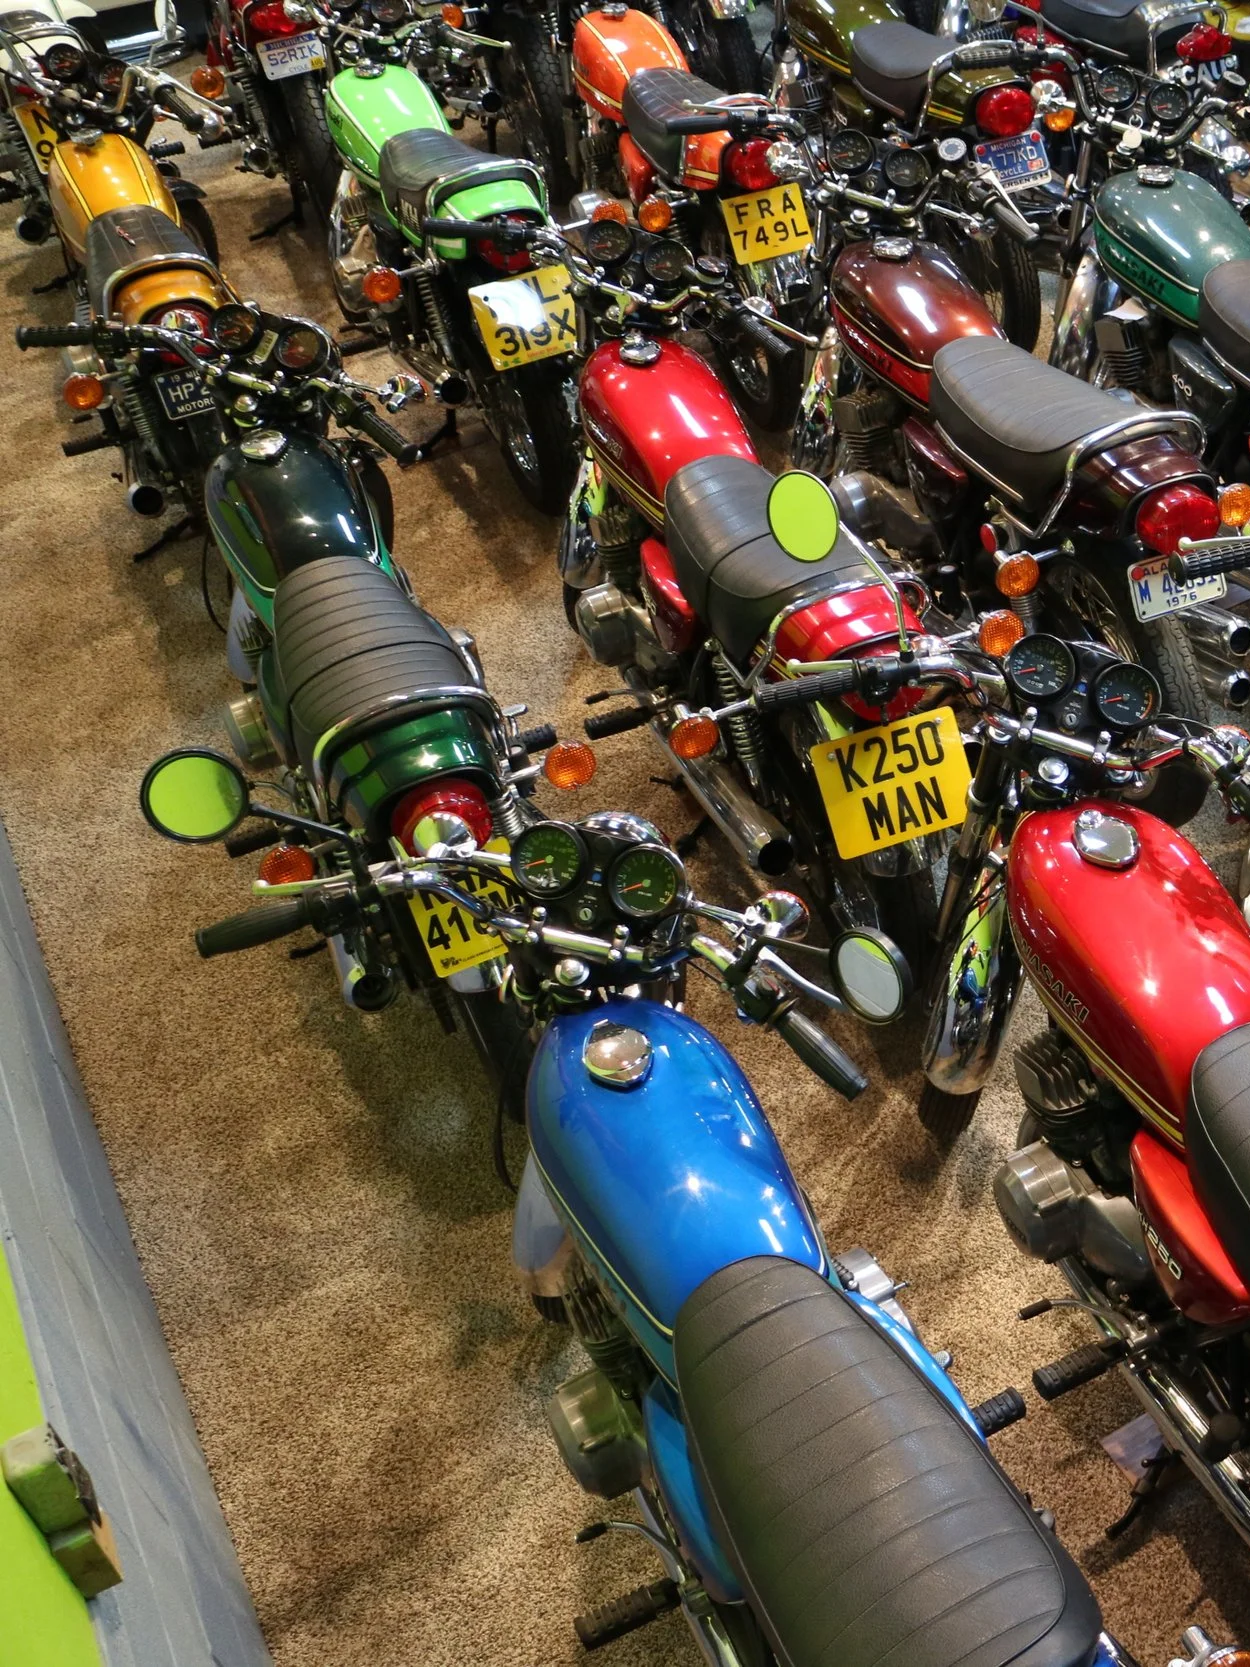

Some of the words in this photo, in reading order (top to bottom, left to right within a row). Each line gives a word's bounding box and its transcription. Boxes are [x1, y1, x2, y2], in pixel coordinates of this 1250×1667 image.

[990, 136, 1027, 152] MICHIGAN
[734, 191, 797, 225] FRA
[732, 217, 809, 251] 749L
[494, 308, 578, 357] 319X
[167, 383, 196, 403] HP
[1172, 373, 1193, 397] 400
[1137, 580, 1152, 604] M
[1166, 591, 1198, 608] 1976
[834, 720, 945, 793] K250
[861, 776, 948, 841] MAN
